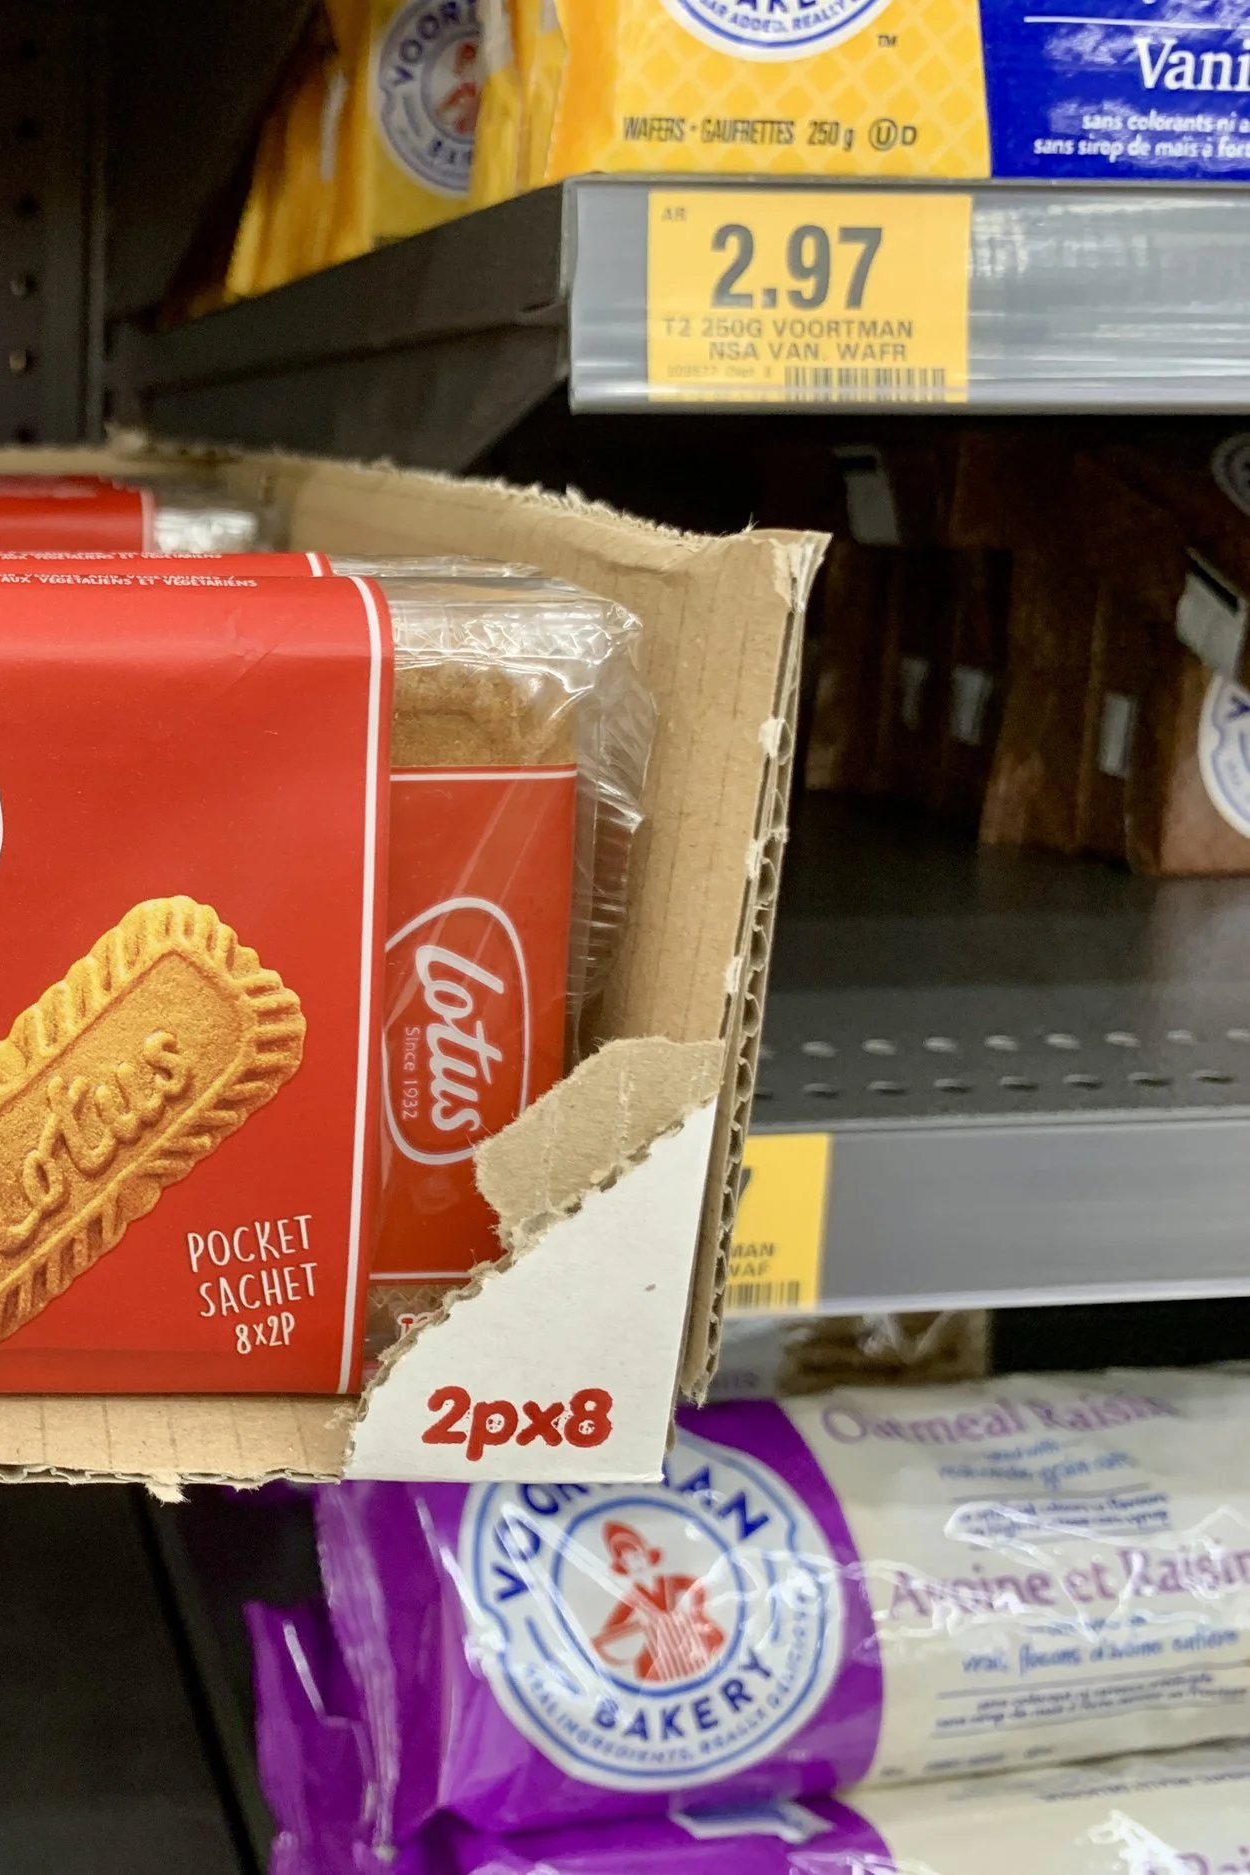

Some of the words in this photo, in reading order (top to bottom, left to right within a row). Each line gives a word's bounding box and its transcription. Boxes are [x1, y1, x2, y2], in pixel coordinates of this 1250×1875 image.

[623, 116, 685, 142] WAFERS
[701, 117, 795, 145] GAUFRETTES
[808, 119, 839, 147] 250
[1082, 115, 1123, 130] sans
[1127, 108, 1213, 133] colorants
[1034, 139, 1075, 155] sans
[1078, 132, 1124, 163] sirop
[1127, 132, 1151, 157] de
[661, 205, 687, 222] AR
[709, 223, 883, 311] 2.97
[662, 318, 692, 338] T2
[700, 318, 762, 338] 250G
[772, 318, 913, 339] VOORTMAN
[708, 341, 759, 361] NSA
[836, 342, 908, 363] WAFR
[1, 575, 31, 583] AUX
[403, 1026, 420, 1072] Since
[415, 945, 505, 1131] Lotus
[402, 1079, 419, 1121] 1932
[187, 1215, 313, 1272] POCKET
[199, 1263, 318, 1318] SACHET
[421, 1386, 614, 1461] 2px8
[1063, 1560, 1116, 1604] et
[593, 1648, 772, 1743] BAKERY
